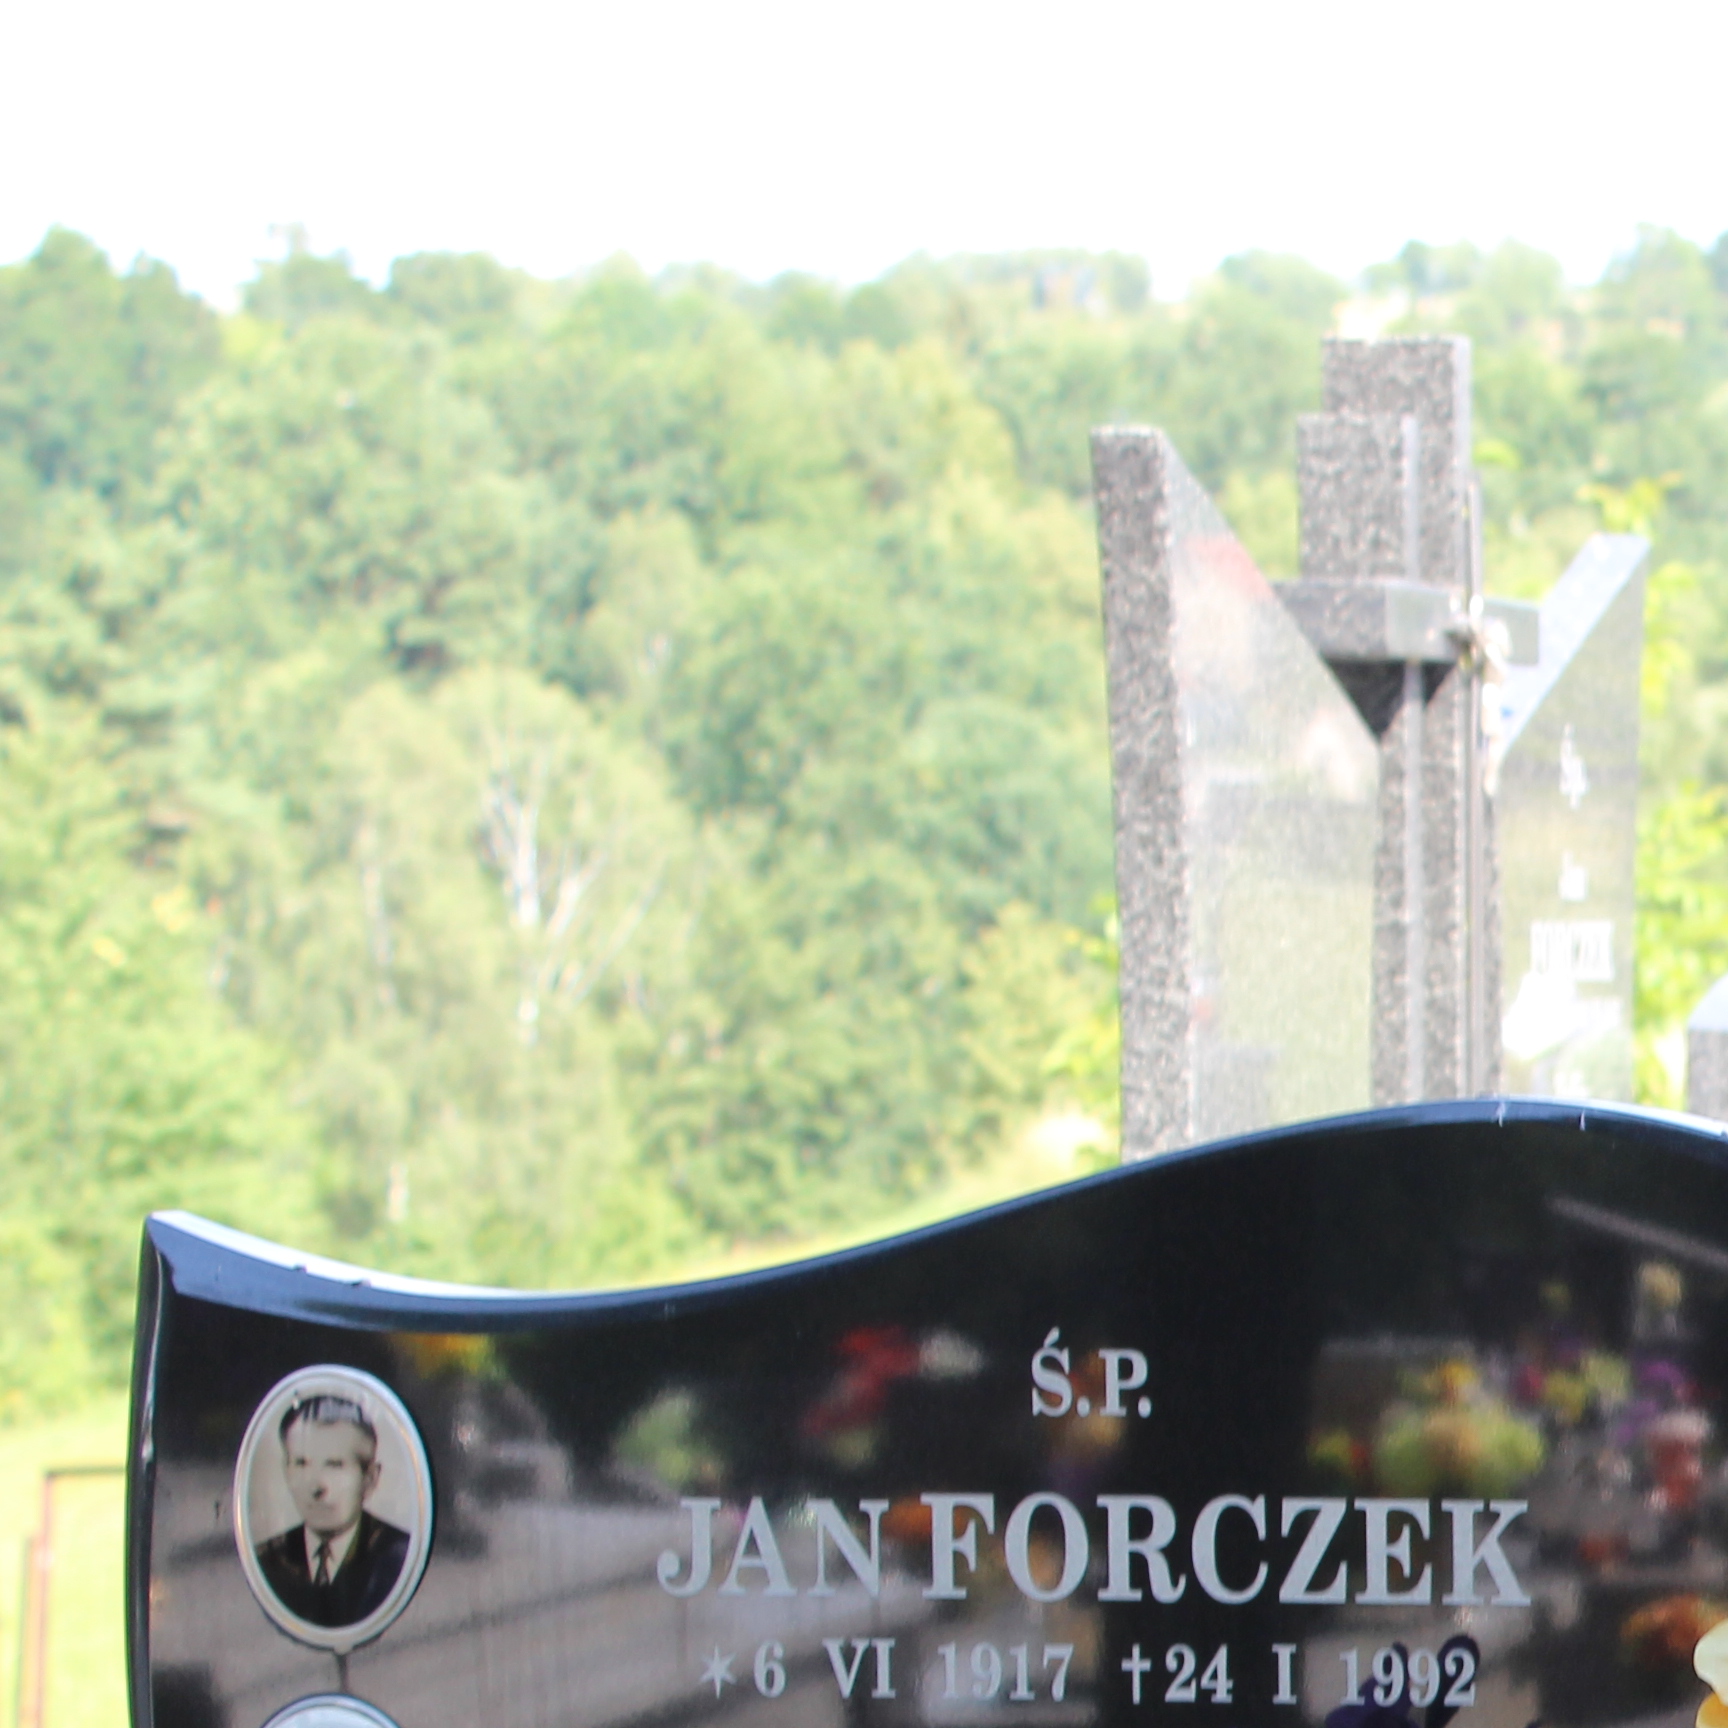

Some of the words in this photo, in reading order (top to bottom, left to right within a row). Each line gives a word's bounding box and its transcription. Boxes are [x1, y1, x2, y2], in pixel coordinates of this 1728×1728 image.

[1031, 1327, 1152, 1419] Ś.P.
[656, 1496, 889, 1598] JAN
[920, 1492, 1532, 1606] FORCZEK
[753, 1640, 787, 1698] 6
[822, 1637, 897, 1699] VI
[936, 1641, 1075, 1701] 1917
[1164, 1643, 1234, 1704] 24
[1271, 1643, 1298, 1705] I
[1339, 1646, 1478, 1708] 1992
